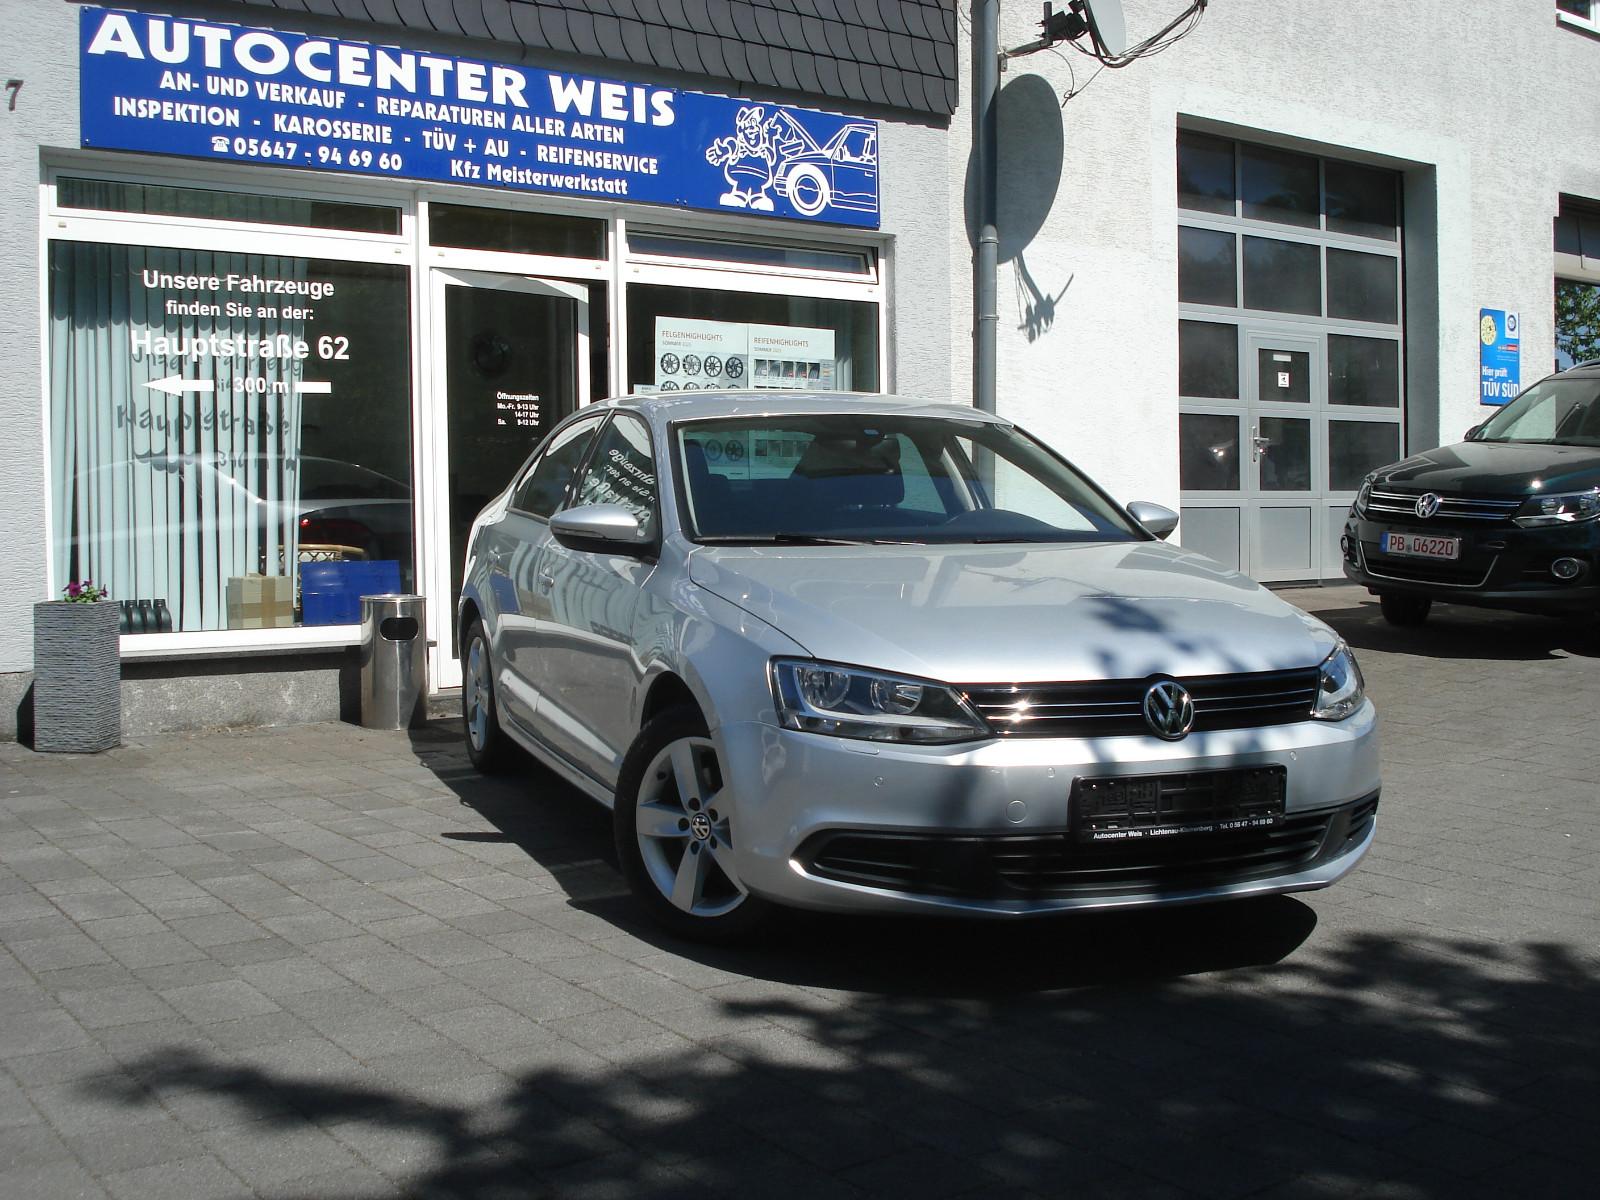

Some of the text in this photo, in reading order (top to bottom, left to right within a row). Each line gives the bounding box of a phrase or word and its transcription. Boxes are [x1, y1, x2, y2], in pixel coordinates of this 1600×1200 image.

[88, 13, 675, 127] AUTOCENTER WEIS
[6, 79, 24, 112] 7
[160, 70, 200, 92] AN-
[206, 75, 249, 98] UND
[255, 80, 345, 110] VERKAUF
[376, 95, 506, 130] REPARATUREN
[511, 113, 566, 137] ALLER
[571, 121, 624, 145] ARTEN
[113, 95, 240, 128] INSPEKTION
[273, 113, 393, 145] KAROSSERIE
[422, 128, 457, 152] TÜV
[463, 138, 477, 153] +
[484, 138, 509, 158] AU
[537, 144, 658, 175] REIFENSERVICE
[233, 136, 298, 160] 05647
[317, 145, 342, 165] 94
[349, 149, 373, 168] 69
[379, 152, 403, 171] 60
[450, 159, 628, 196] Kfz Meisterwerkstatt
[143, 269, 335, 302] Unsere Fahrzeuge
[166, 301, 315, 321] finden Sie an der:
[130, 329, 310, 362] Hauptstraße
[317, 335, 351, 361] 62
[661, 330, 724, 342] FELGENHIGHLIGHTS
[753, 337, 810, 348] REIFENHIGHLIGHTS
[1482, 365, 1495, 377] Hier
[232, 376, 290, 394] 300 m
[1482, 378, 1520, 398] TÜV SÜD
[496, 391, 540, 401] Öffnungszeiten
[529, 418, 540, 426] Uhr
[1389, 535, 1455, 557] PB 06220
[1093, 831, 1128, 840] Autocenter
[1128, 830, 1143, 838] Weis
